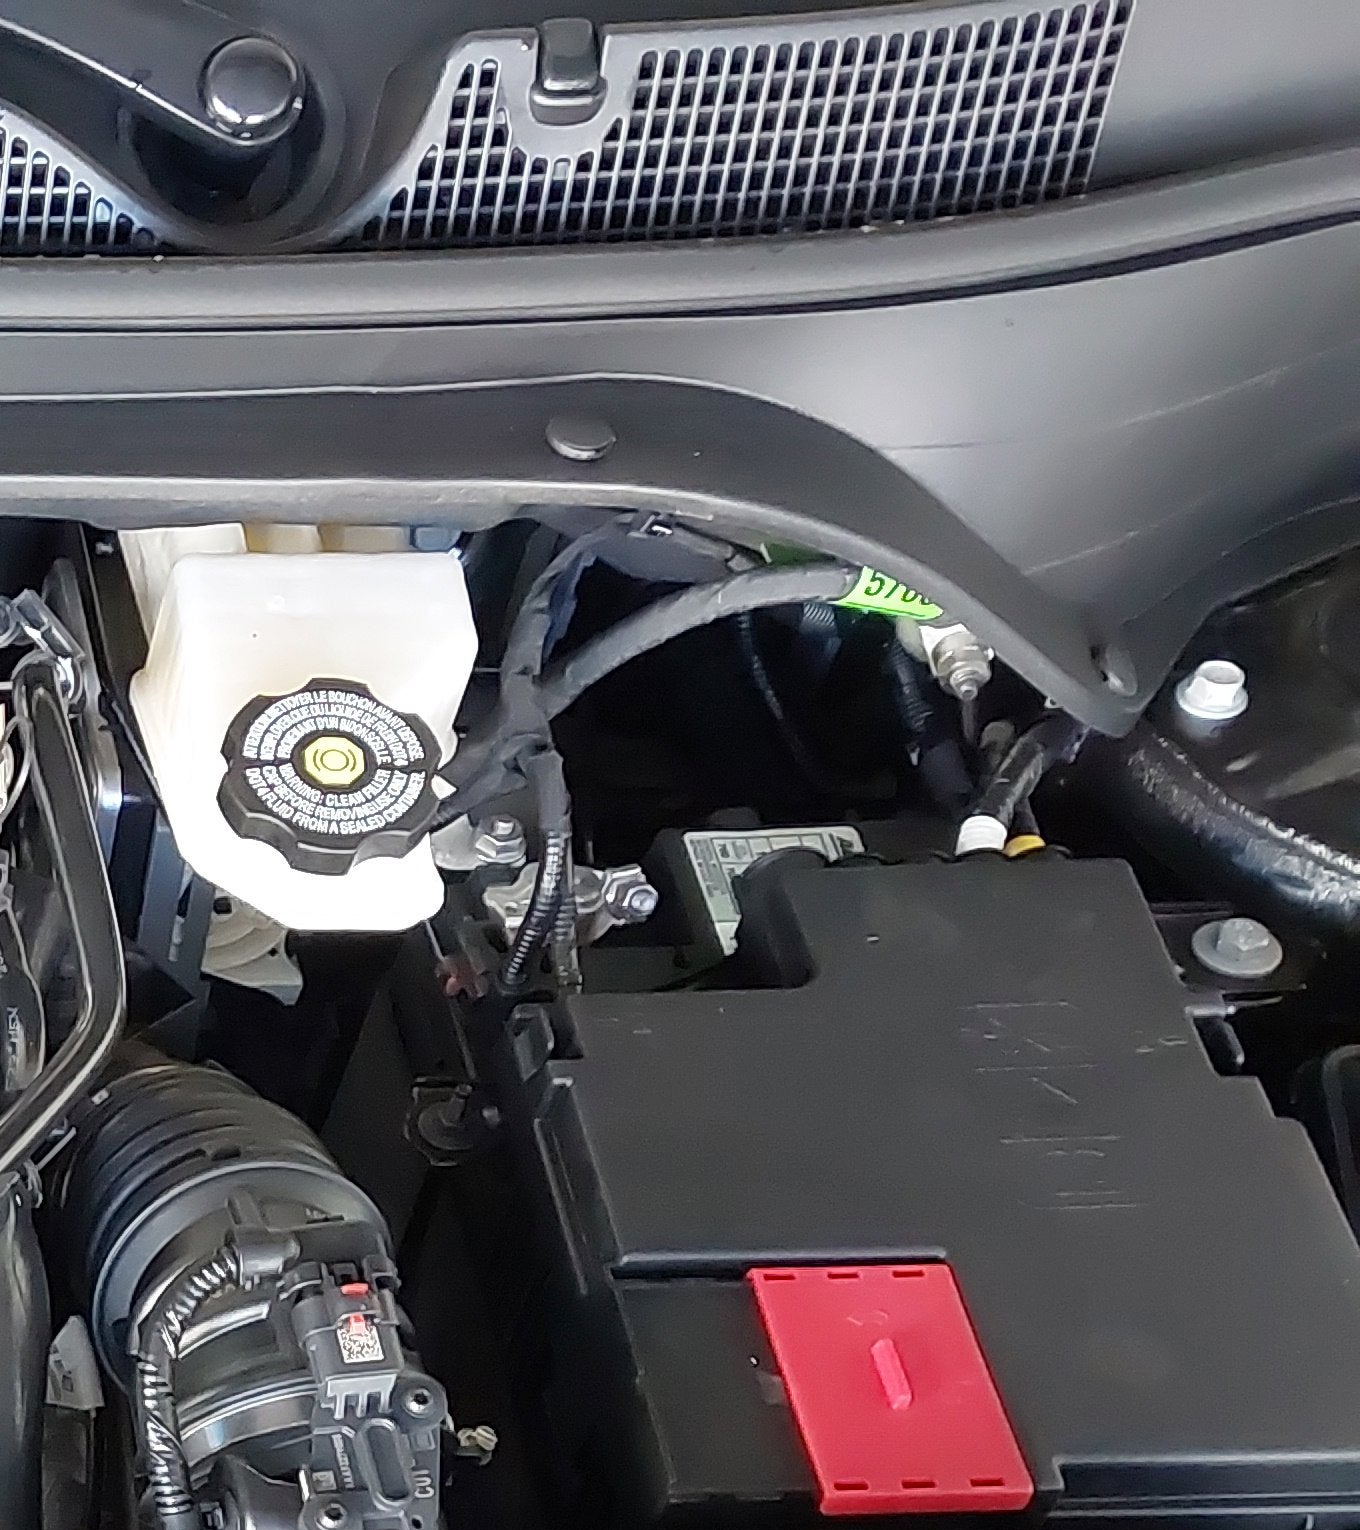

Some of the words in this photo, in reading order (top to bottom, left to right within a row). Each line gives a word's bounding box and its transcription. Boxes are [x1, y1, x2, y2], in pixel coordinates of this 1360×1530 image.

[313, 691, 327, 703] LE
[328, 691, 377, 713] BOUCHON
[361, 712, 379, 728] DE
[274, 783, 317, 814] BEFORE
[325, 791, 366, 807] CLEAN
[261, 791, 295, 819] FLUID
[292, 811, 329, 834] FROM
[329, 820, 339, 834] A
[340, 814, 386, 834] SEALED
